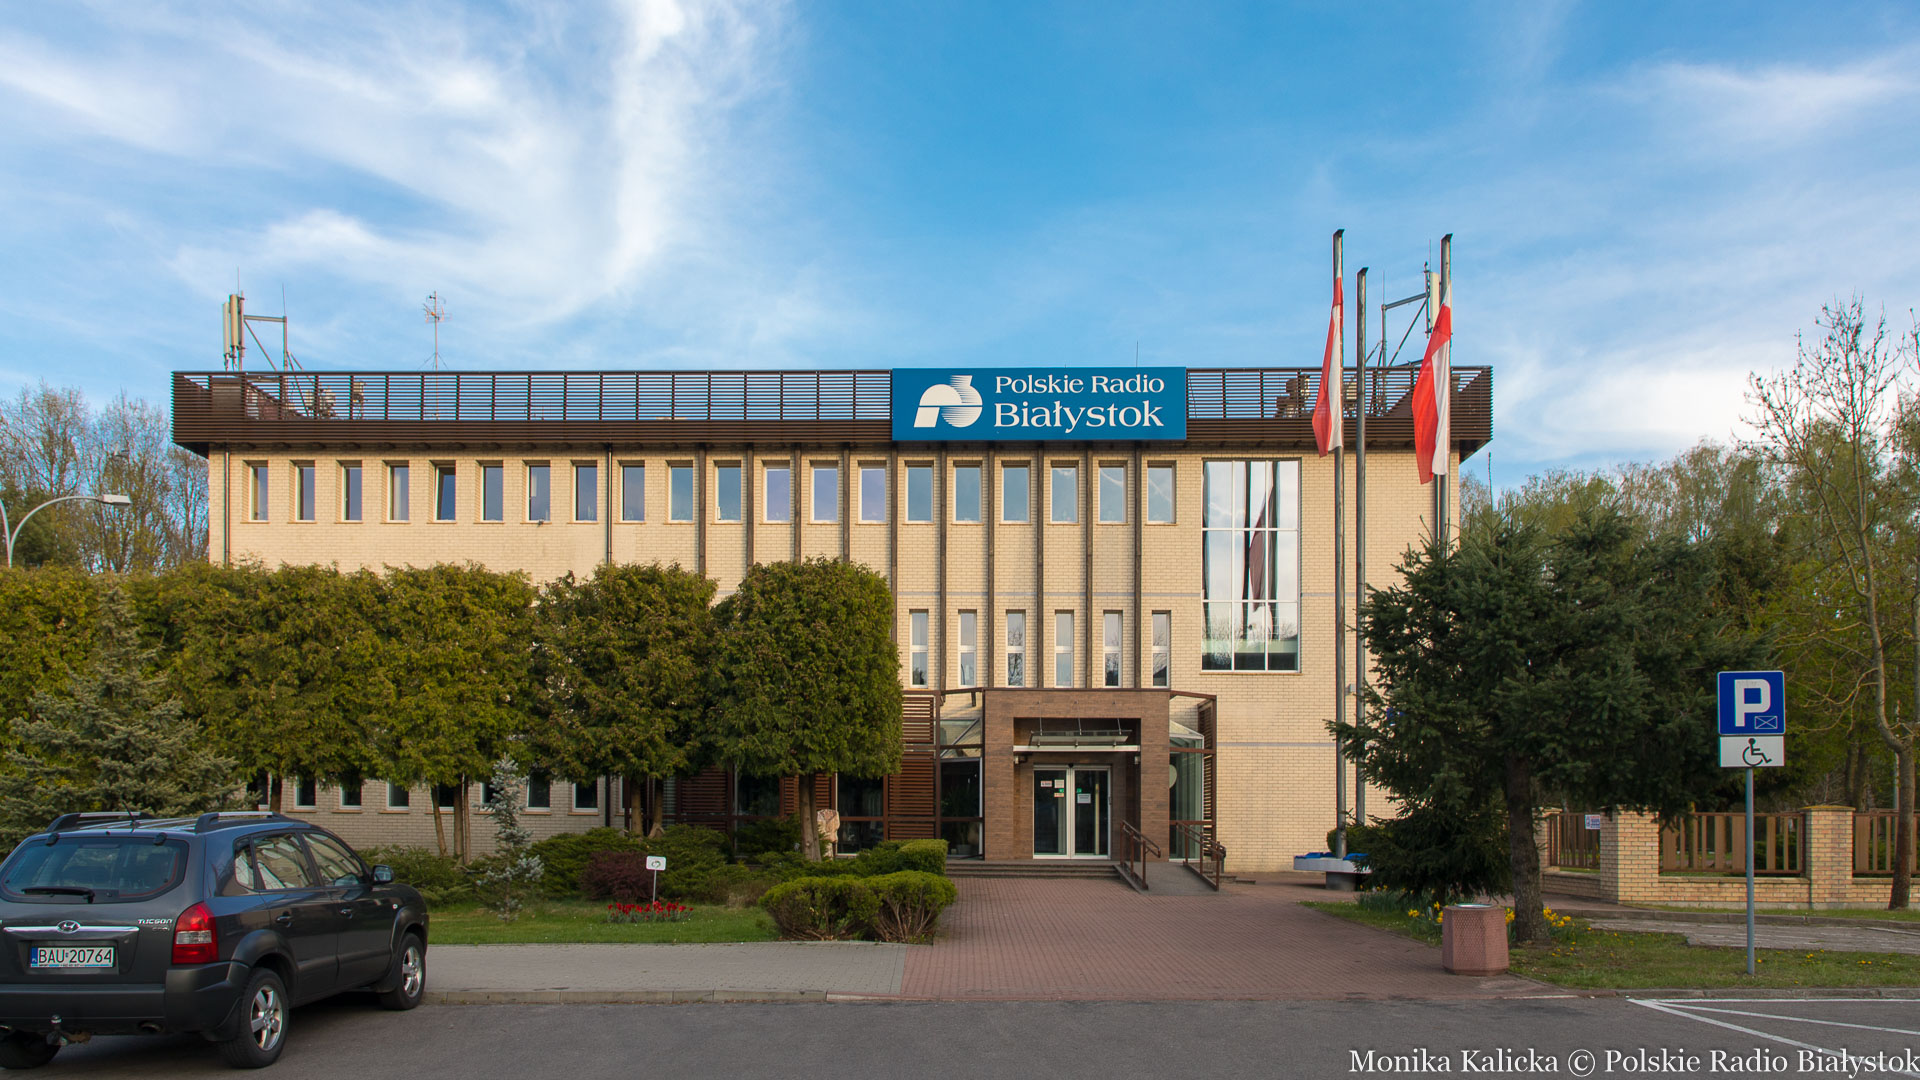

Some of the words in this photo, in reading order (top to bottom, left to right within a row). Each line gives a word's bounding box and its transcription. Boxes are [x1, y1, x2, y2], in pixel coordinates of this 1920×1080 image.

[995, 374, 1084, 394] Polskie
[1091, 374, 1165, 393] Radio
[994, 400, 1165, 433] Białystok
[1734, 679, 1771, 727] P
[38, 948, 66, 964] BAU
[69, 948, 113, 964] 20764
